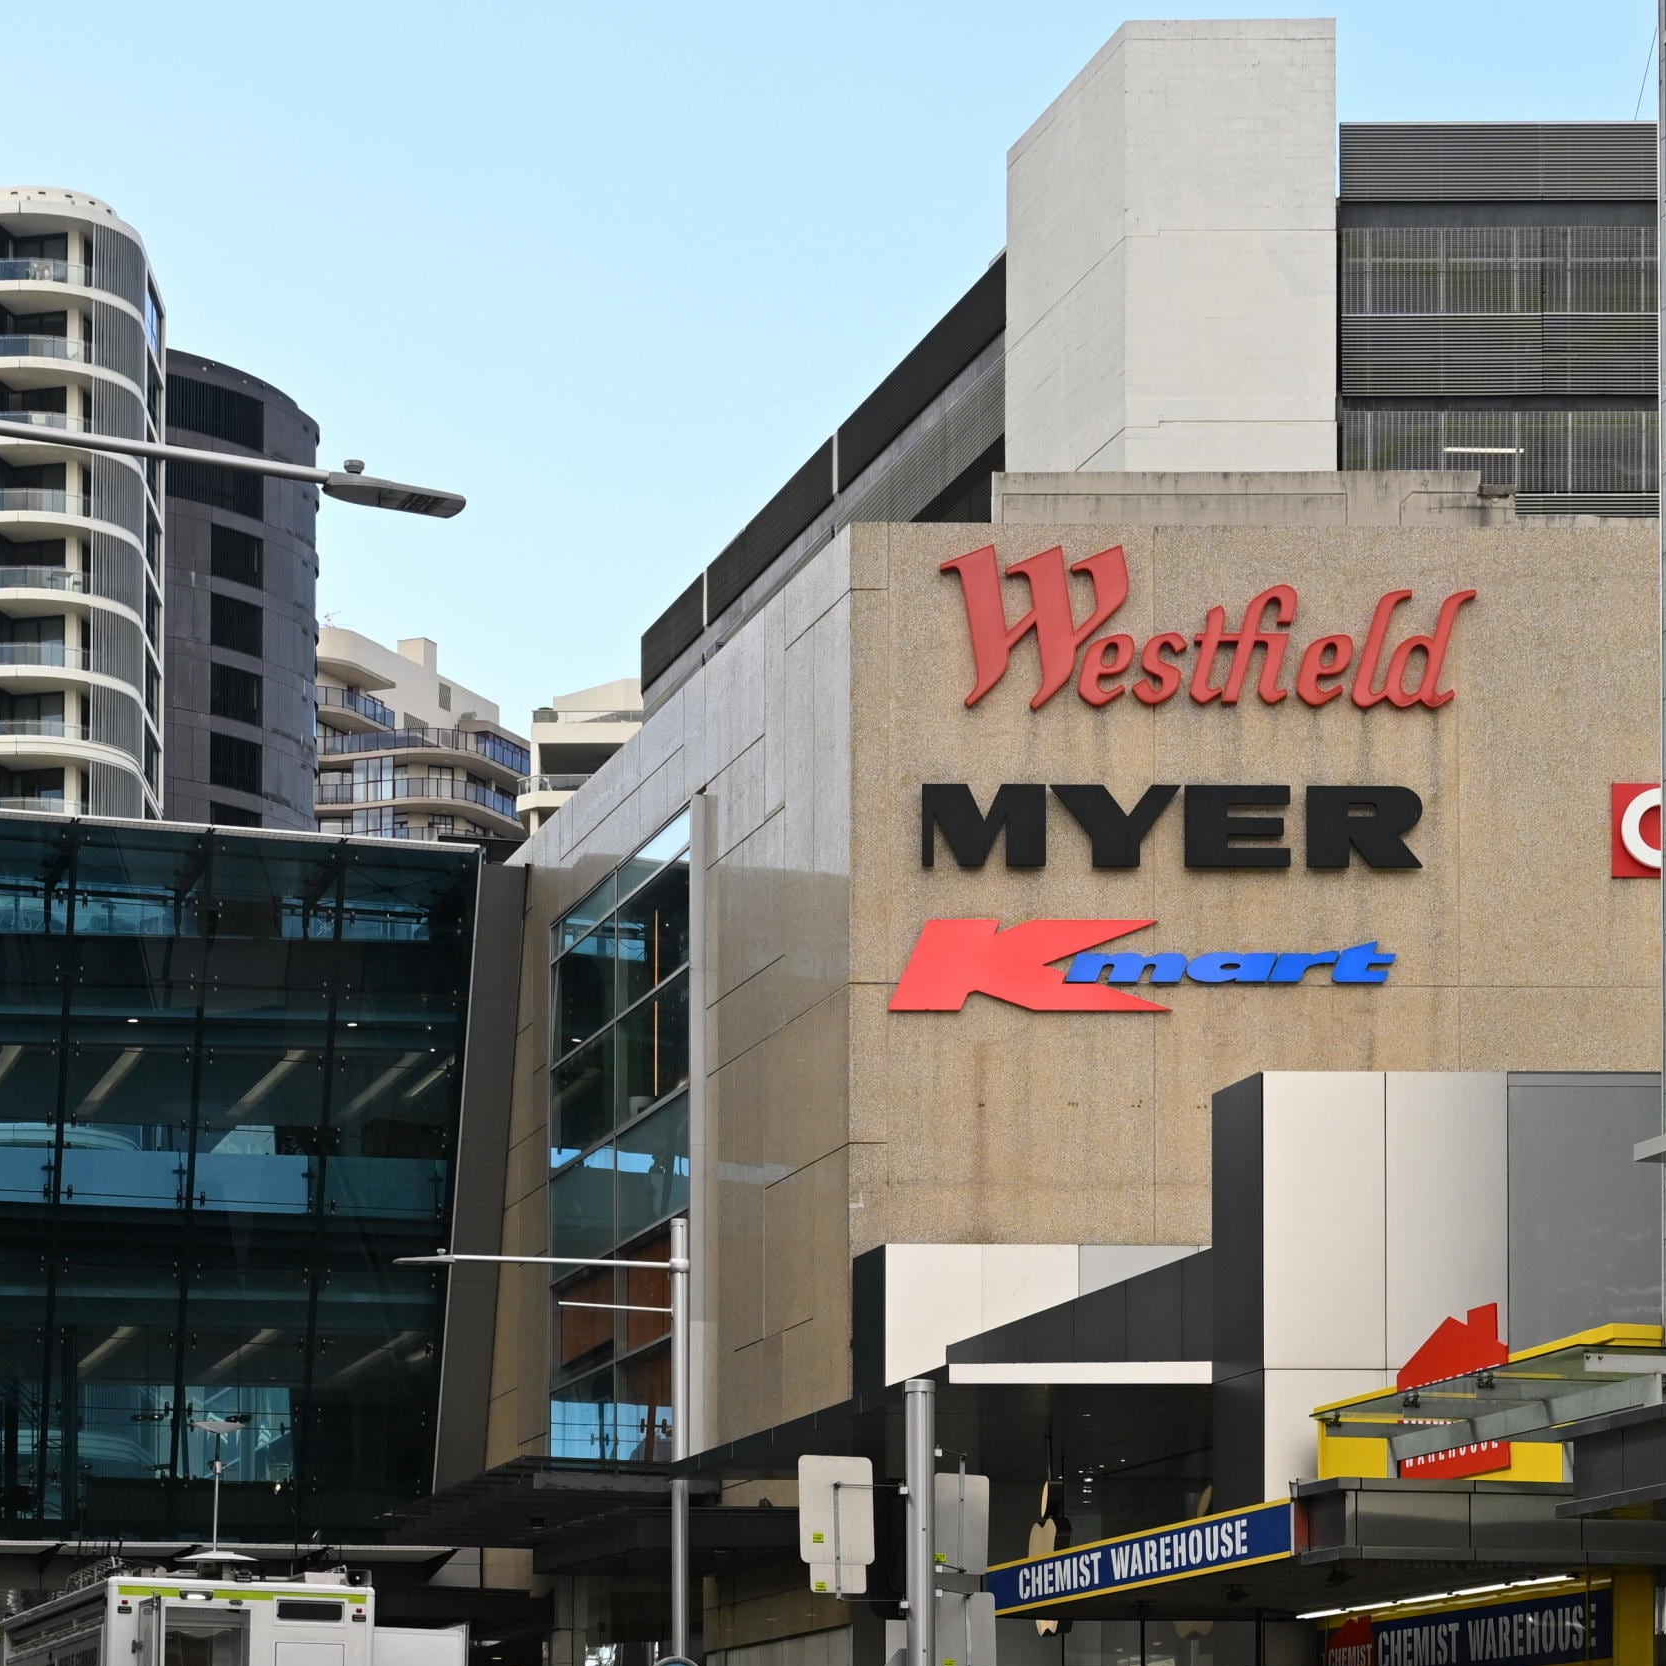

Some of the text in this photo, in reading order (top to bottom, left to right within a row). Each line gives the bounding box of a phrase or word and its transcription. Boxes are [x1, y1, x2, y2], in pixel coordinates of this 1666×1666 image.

[939, 544, 1477, 710] Westfield
[921, 783, 1423, 870] MYER
[888, 918, 1397, 1012] Kmart
[1018, 1518, 1248, 1601] CHEMIST WAREHOUSE
[1467, 1603, 1597, 1662] WAREHOUSE
